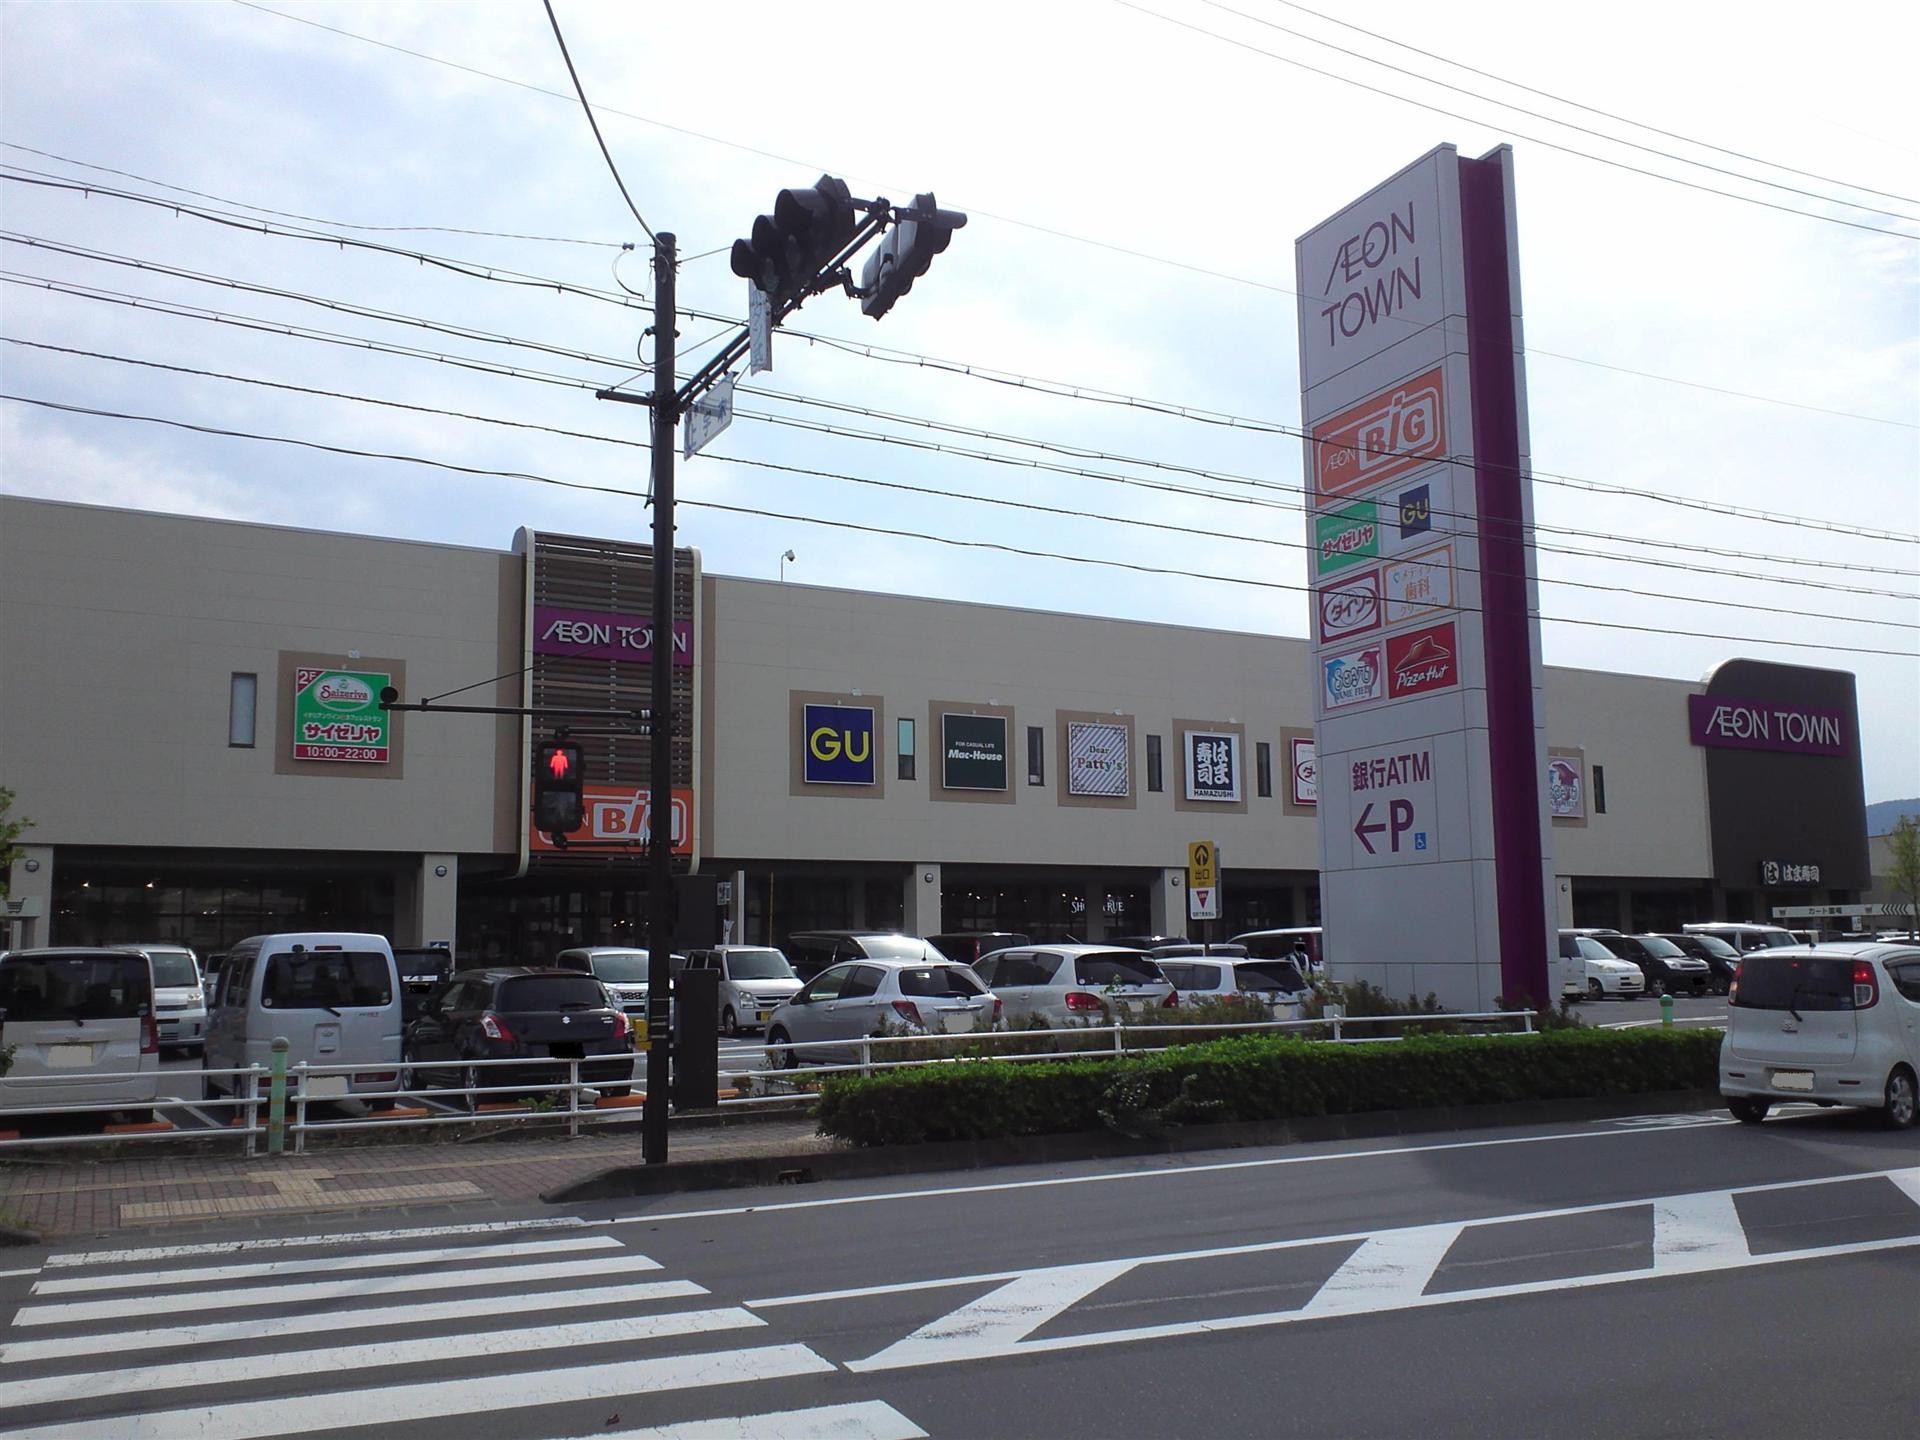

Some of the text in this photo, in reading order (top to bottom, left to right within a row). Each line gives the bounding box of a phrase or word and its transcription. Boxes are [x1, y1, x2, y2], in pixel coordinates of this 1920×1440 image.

[1321, 256, 1421, 346] TOWN
[1366, 396, 1426, 461] BIG
[1401, 497, 1430, 524] GU
[1321, 525, 1375, 560] サイゼリヤ
[1406, 576, 1429, 601] 歯科
[1331, 595, 1373, 622] ダイソー
[617, 626, 687, 652] TON
[298, 671, 316, 684] 2F
[1396, 664, 1449, 690] Pizza Hut
[320, 685, 368, 701] Saizeriya
[304, 722, 381, 743] サイゼリヤ
[1774, 711, 1840, 745] TOWN
[810, 727, 869, 763] GU
[948, 749, 1003, 761] Mac-House
[1076, 757, 1123, 772] Patty's
[1196, 741, 1211, 785] 寿司
[1211, 741, 1229, 784] はま
[1352, 751, 1431, 791] 銀行ATM
[1193, 789, 1234, 798] HAMAZUSHI
[602, 793, 653, 834] BI
[1390, 799, 1415, 852] P
[1195, 869, 1210, 880] 出口
[1783, 865, 1820, 882] はま寿司
